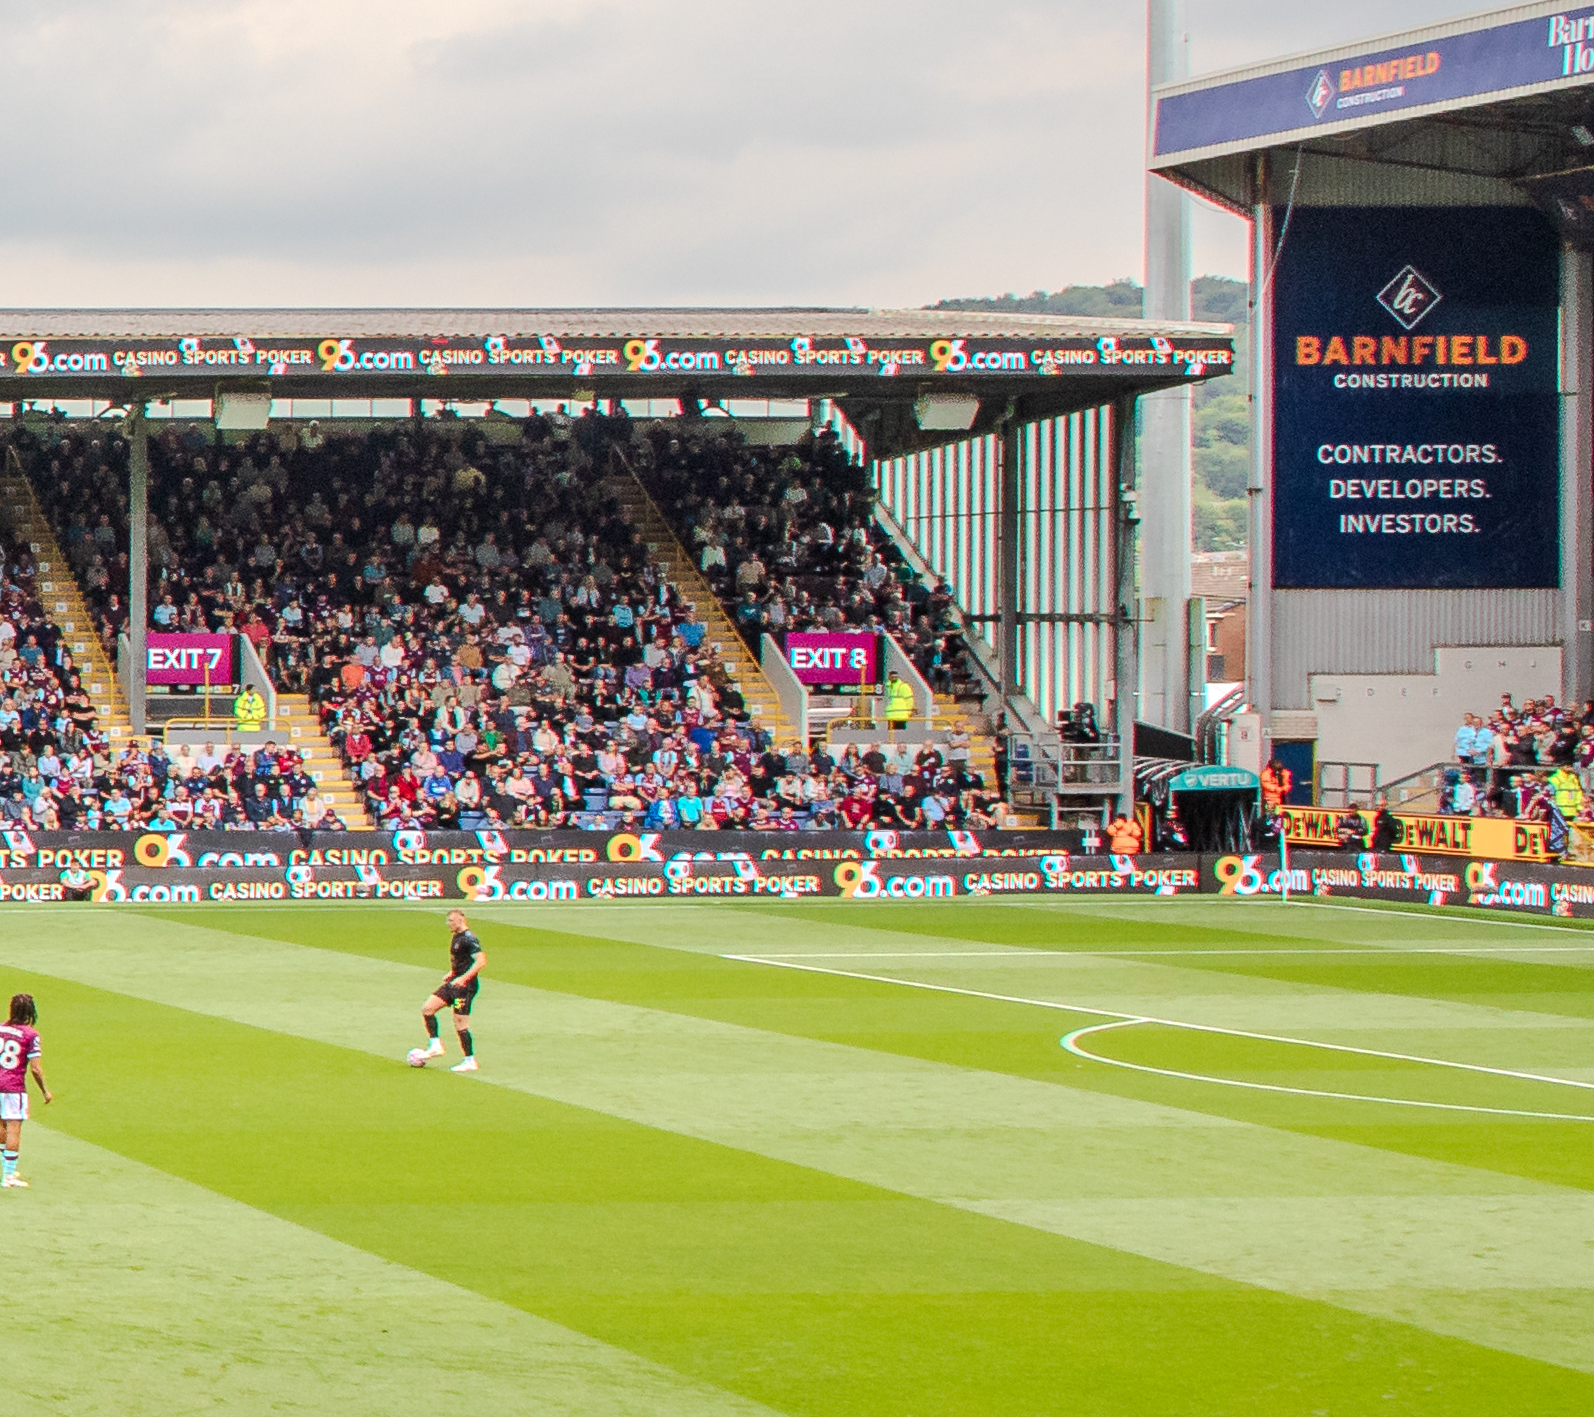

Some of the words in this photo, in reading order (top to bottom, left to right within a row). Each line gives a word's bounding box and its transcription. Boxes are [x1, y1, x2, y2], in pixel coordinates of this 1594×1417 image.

[1339, 52, 1441, 91] BARNFIELD
[1337, 86, 1405, 110] CONSTRUCTION
[12, 340, 107, 372] 96.com
[113, 350, 177, 364] CASINO
[183, 350, 253, 364] SPORTS
[256, 350, 311, 364] POKER
[930, 339, 1025, 372] 96.com
[1031, 350, 1095, 364] CASINO
[1101, 350, 1172, 364] SPORTS
[1175, 350, 1229, 364] POKER
[1296, 335, 1528, 365] BARNFIELD
[1334, 373, 1488, 388] CONSTRUCTION
[1317, 444, 1502, 464] CONTRACTORS.
[1330, 479, 1491, 499] DEVELOPERS.
[1339, 514, 1480, 534] INVESTORS.
[148, 648, 207, 670] EXIT
[207, 648, 223, 670] 7
[792, 647, 848, 669] EXIT
[850, 647, 866, 669] 8
[1200, 773, 1250, 787] VERTU
[1283, 811, 1339, 839] DEWA
[37, 850, 123, 870] POKER
[586, 878, 664, 895] CASINO
[667, 877, 745, 894] SPORTS
[753, 876, 820, 893] POKER
[833, 861, 958, 899] 96.com
[964, 872, 1040, 890] CASINO
[1045, 871, 1125, 889] SPORTS
[1130, 870, 1199, 888] POKER
[1214, 854, 1311, 895] 96.com
[1312, 868, 1360, 887] CASINO
[1362, 868, 1411, 887] SPORTS
[1415, 870, 1459, 893] POKER
[1551, 882, 1594, 906] CASIN
